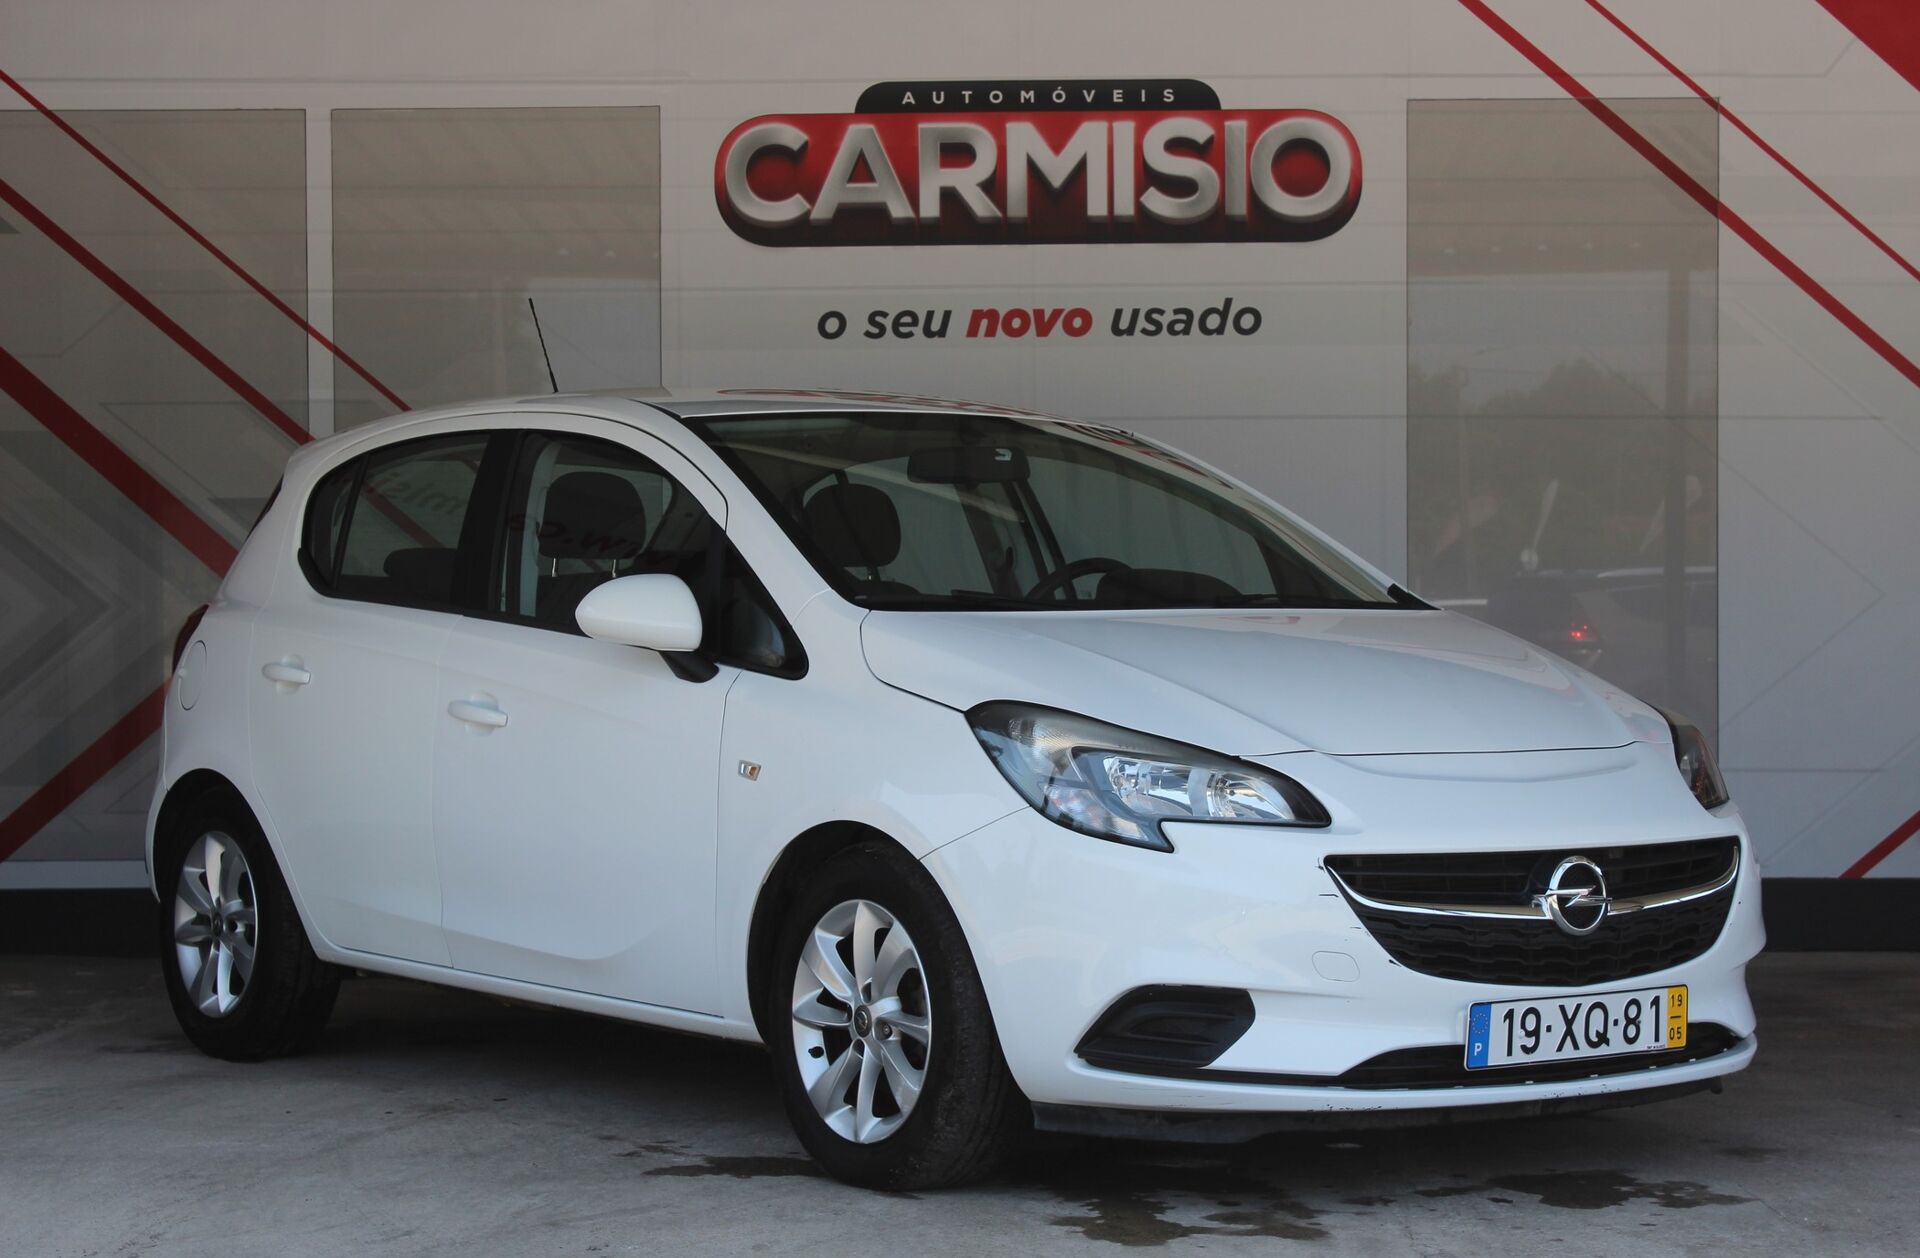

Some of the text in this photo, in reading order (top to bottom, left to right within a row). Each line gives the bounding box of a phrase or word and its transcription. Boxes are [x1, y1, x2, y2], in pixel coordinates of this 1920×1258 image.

[902, 86, 1176, 105] AUTOMÓVEIS
[724, 117, 1352, 224] CARMISIO
[817, 298, 1262, 340] o seu novo usado
[1671, 994, 1683, 1008] 19
[1669, 1026, 1682, 1041] 05
[1474, 1042, 1482, 1056] P
